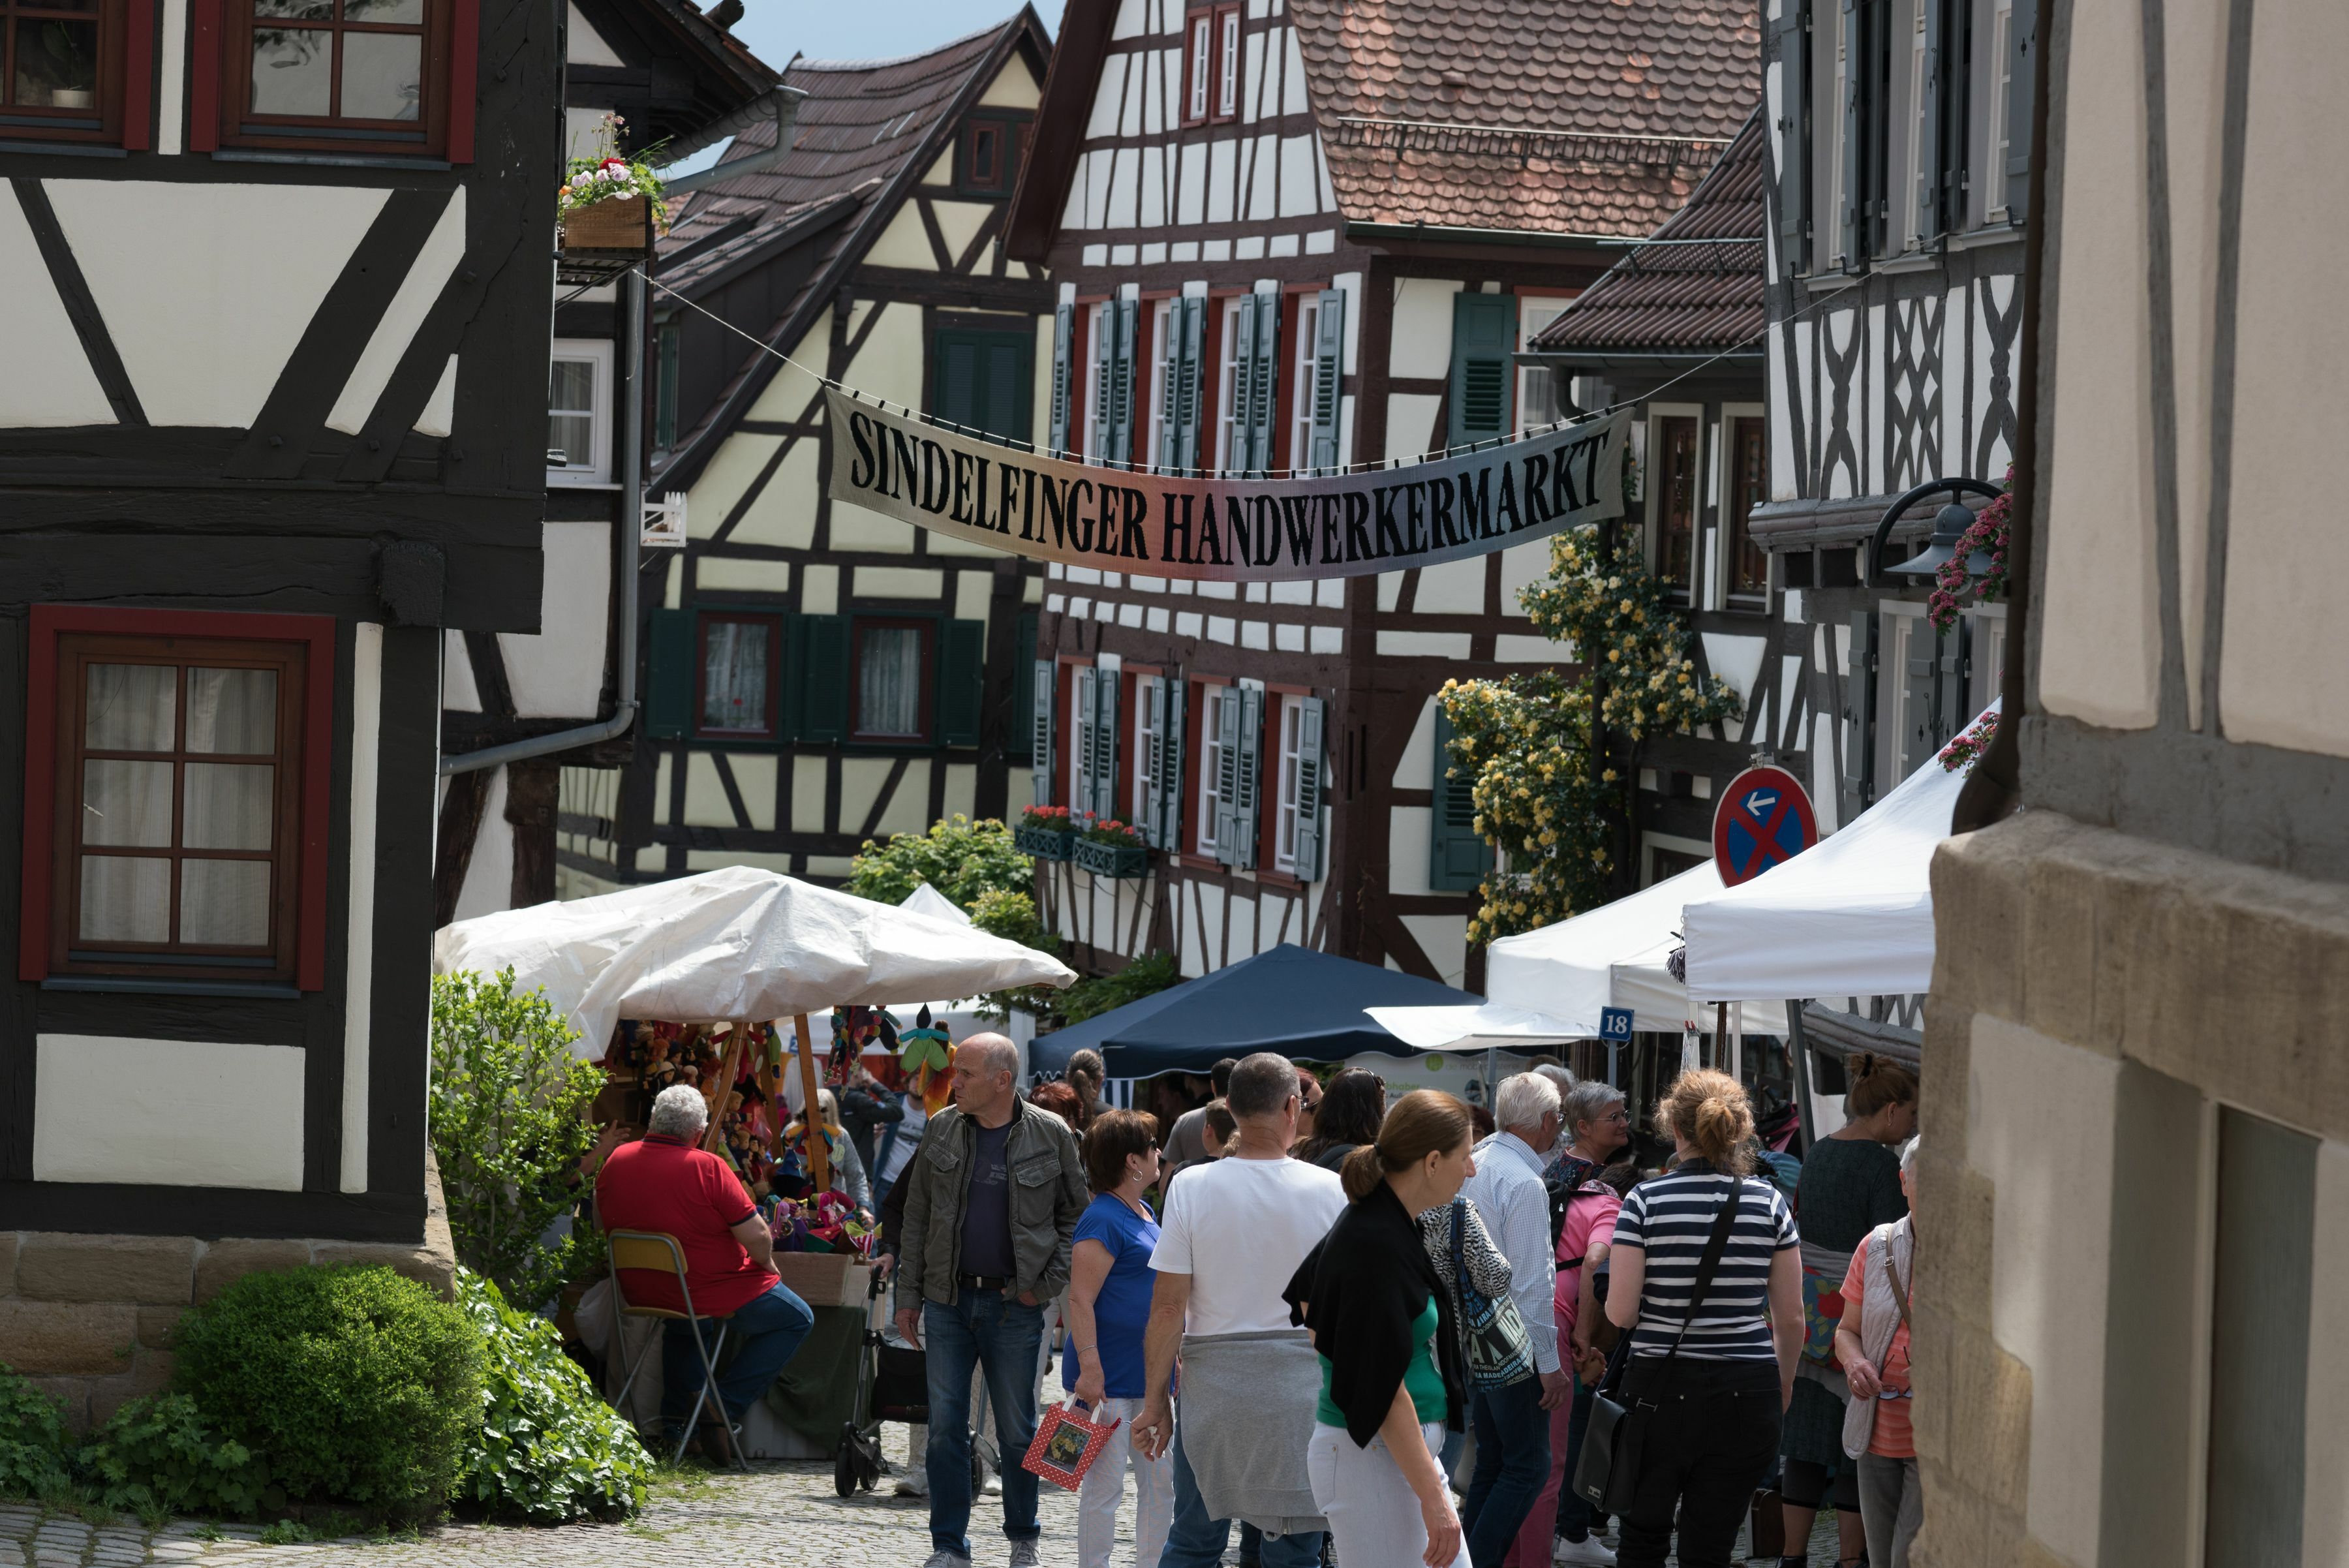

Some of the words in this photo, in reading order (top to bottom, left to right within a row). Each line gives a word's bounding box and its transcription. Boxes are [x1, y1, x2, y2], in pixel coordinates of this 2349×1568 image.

[850, 410, 1150, 561] SINDELFINGER
[1160, 427, 1611, 568] HANDWERKERMARKT
[1605, 1015, 1627, 1034] 18
